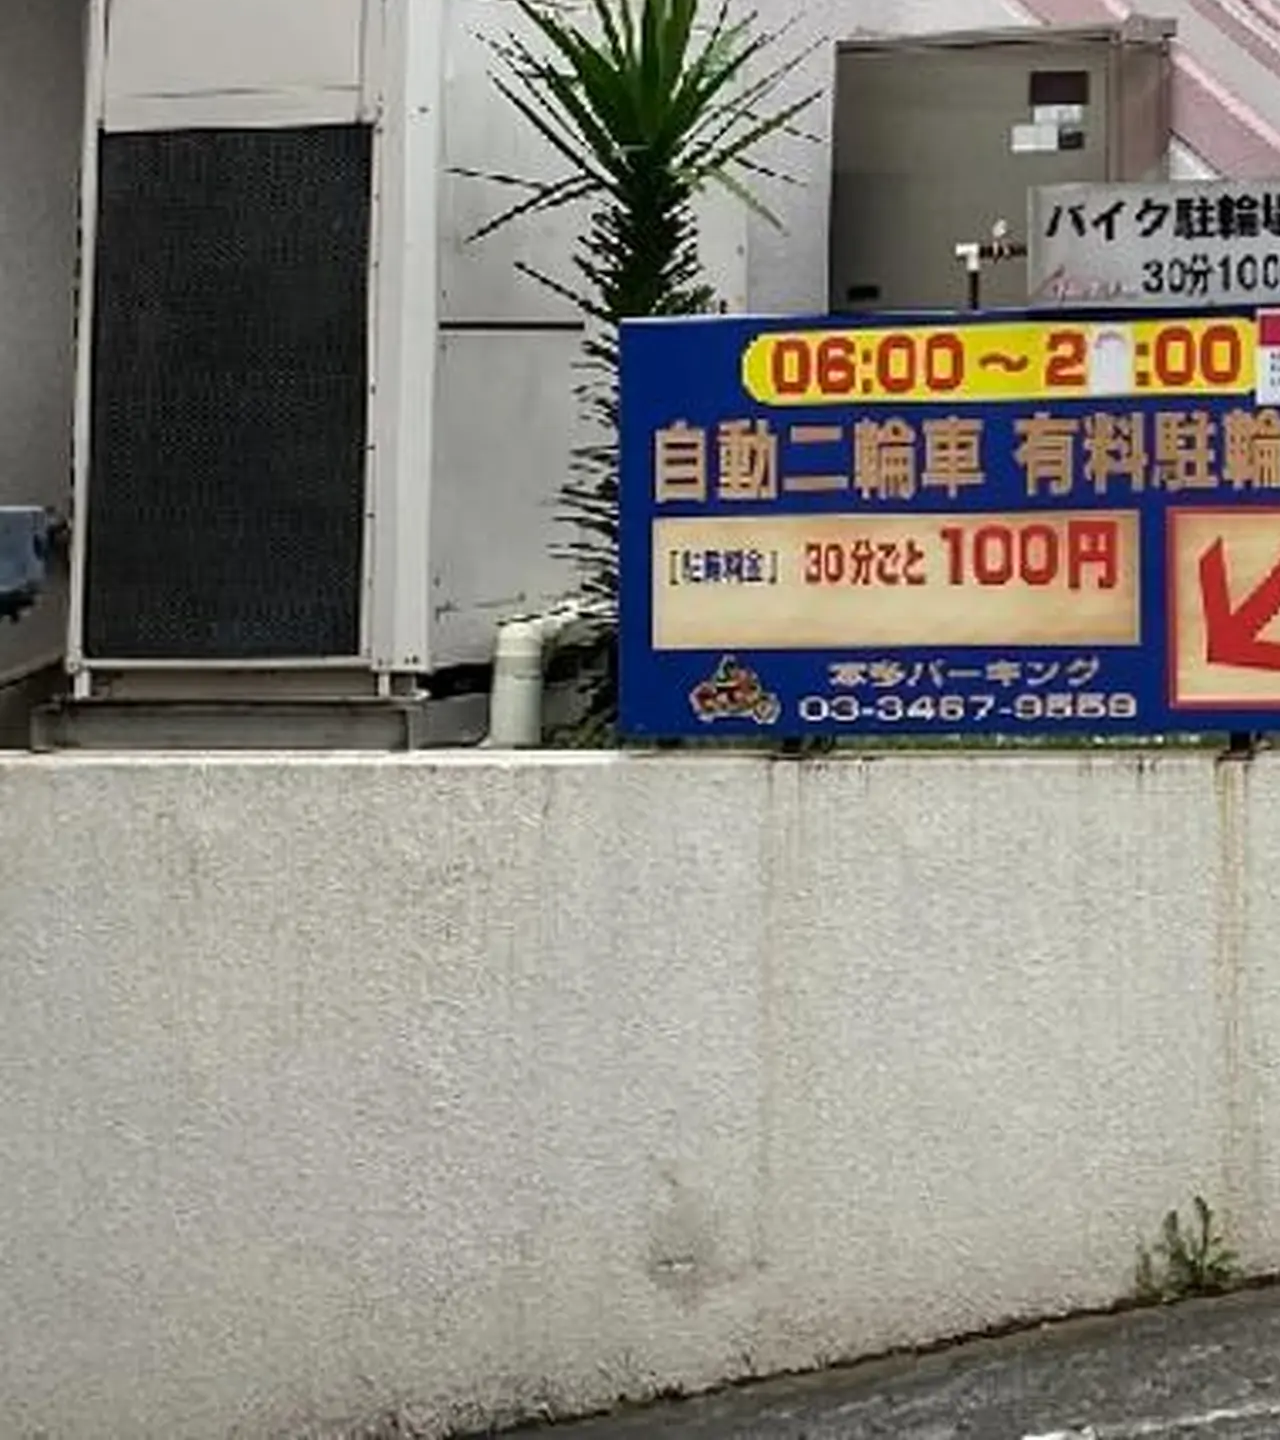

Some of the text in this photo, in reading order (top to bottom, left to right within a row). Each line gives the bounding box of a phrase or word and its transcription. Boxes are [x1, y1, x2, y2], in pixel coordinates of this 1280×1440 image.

[653, 415, 987, 503] 自動二輪車
[938, 520, 1120, 591] 100円
[827, 655, 1100, 688] 本多パーキング
